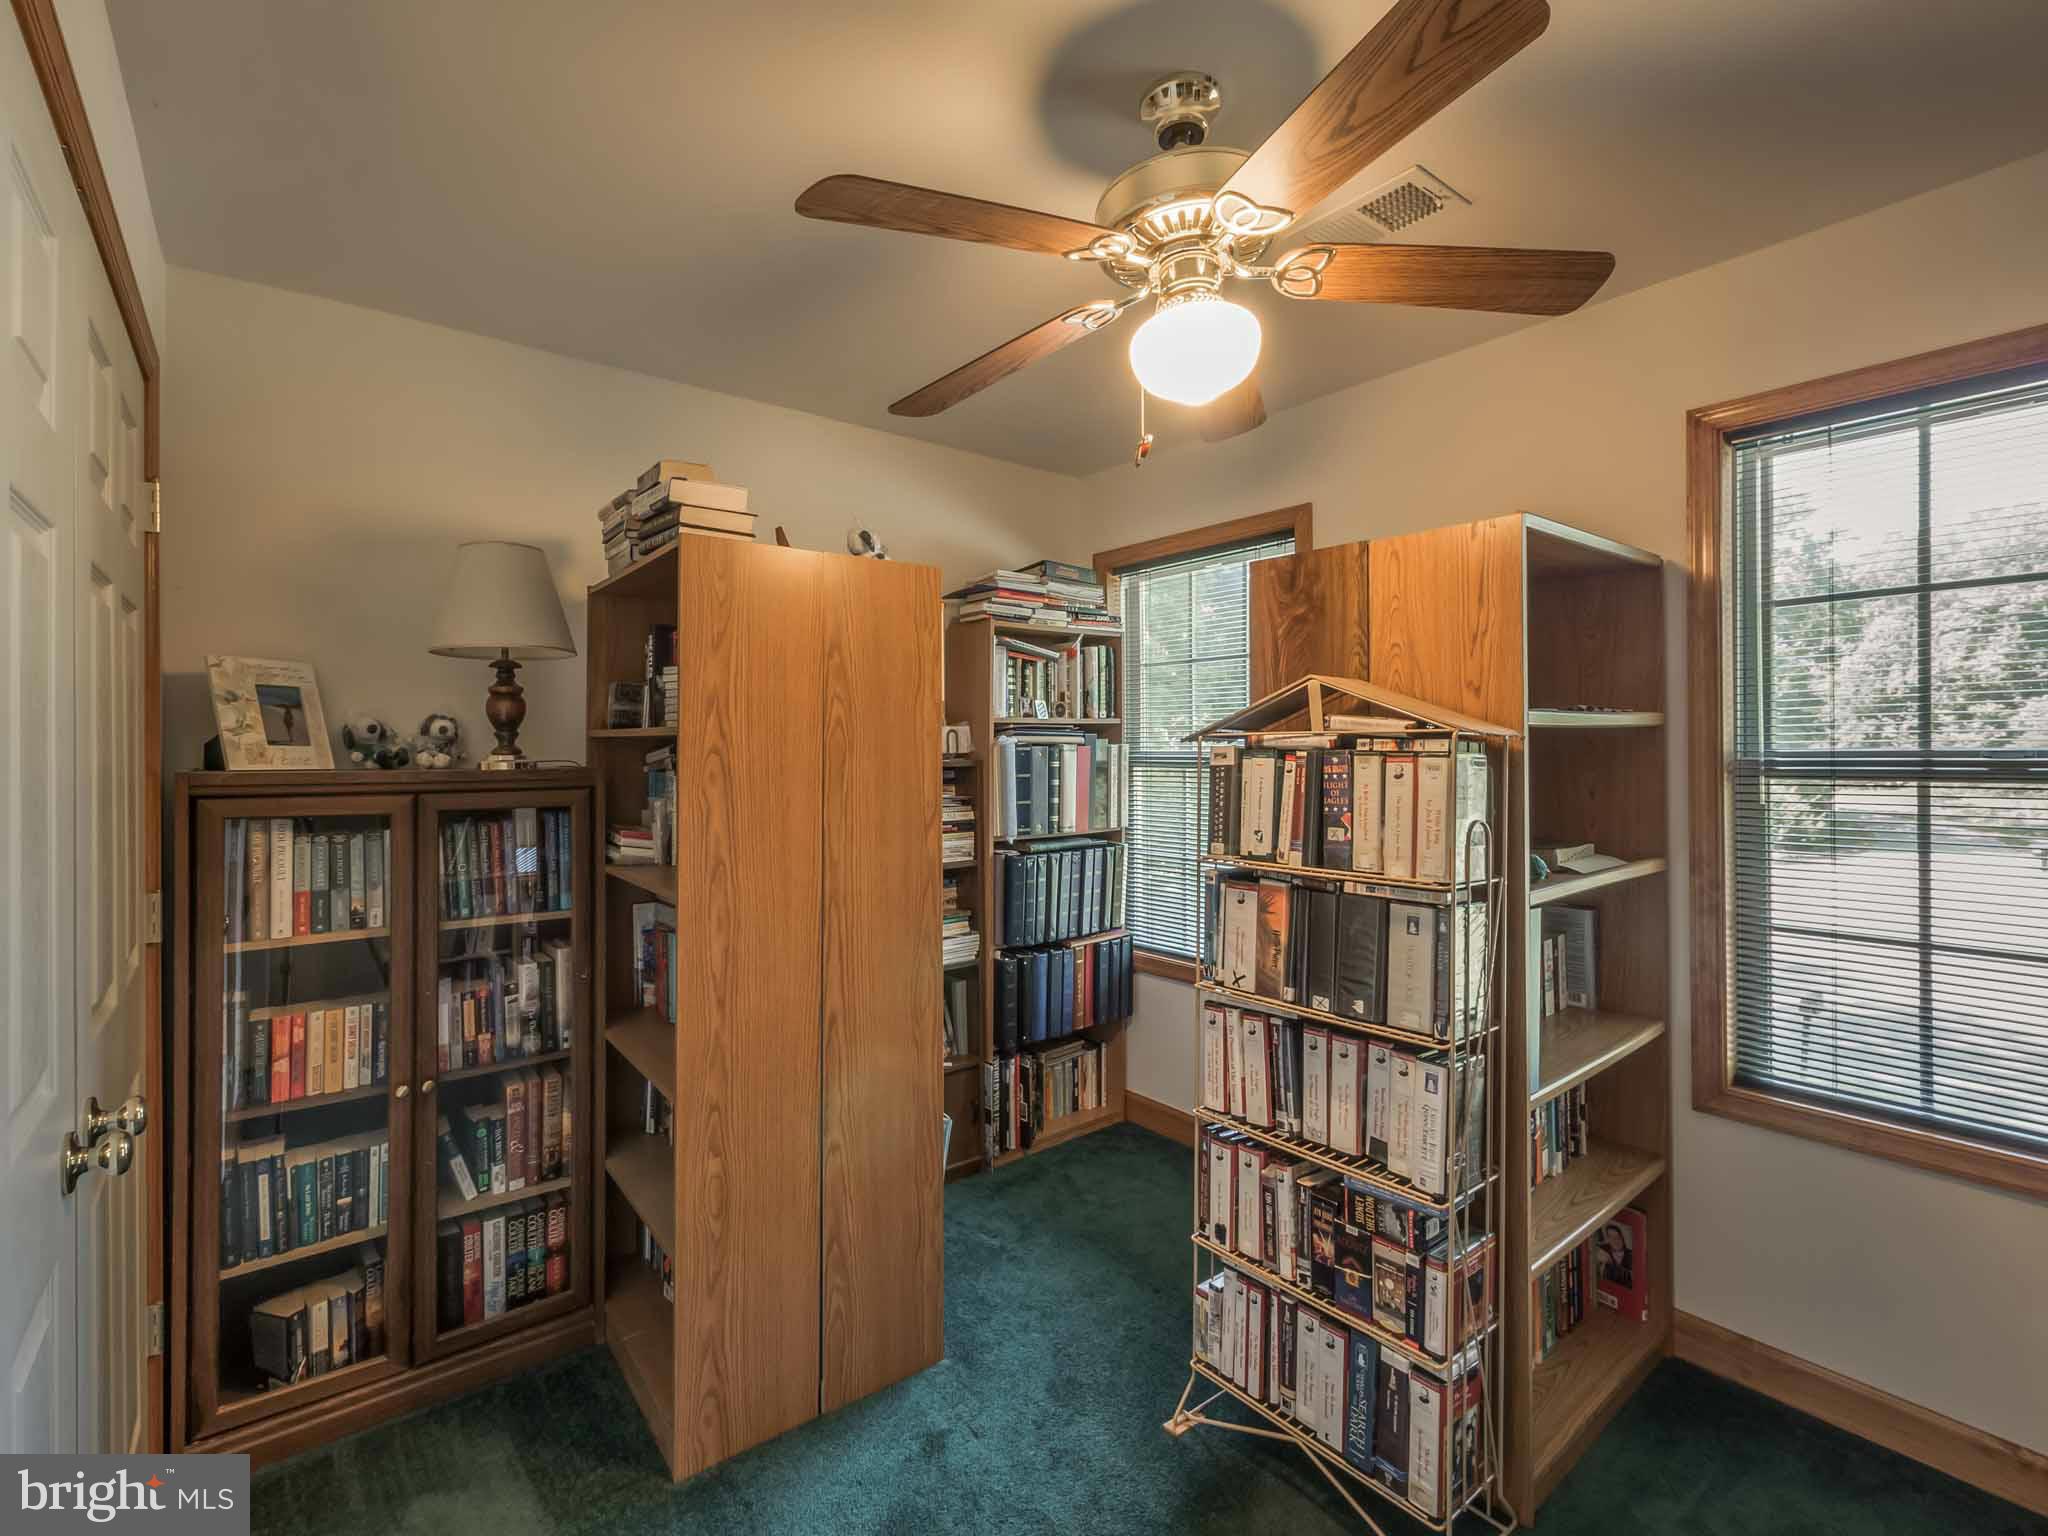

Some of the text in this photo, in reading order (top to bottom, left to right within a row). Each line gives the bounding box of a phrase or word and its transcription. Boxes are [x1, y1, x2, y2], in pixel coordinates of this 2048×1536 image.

[1355, 1195, 1365, 1225] SIDNEY
[1364, 1196, 1375, 1232] SHELDON
[1349, 1406, 1359, 1441] DARK
[1358, 1399, 1368, 1450] SEARCH
